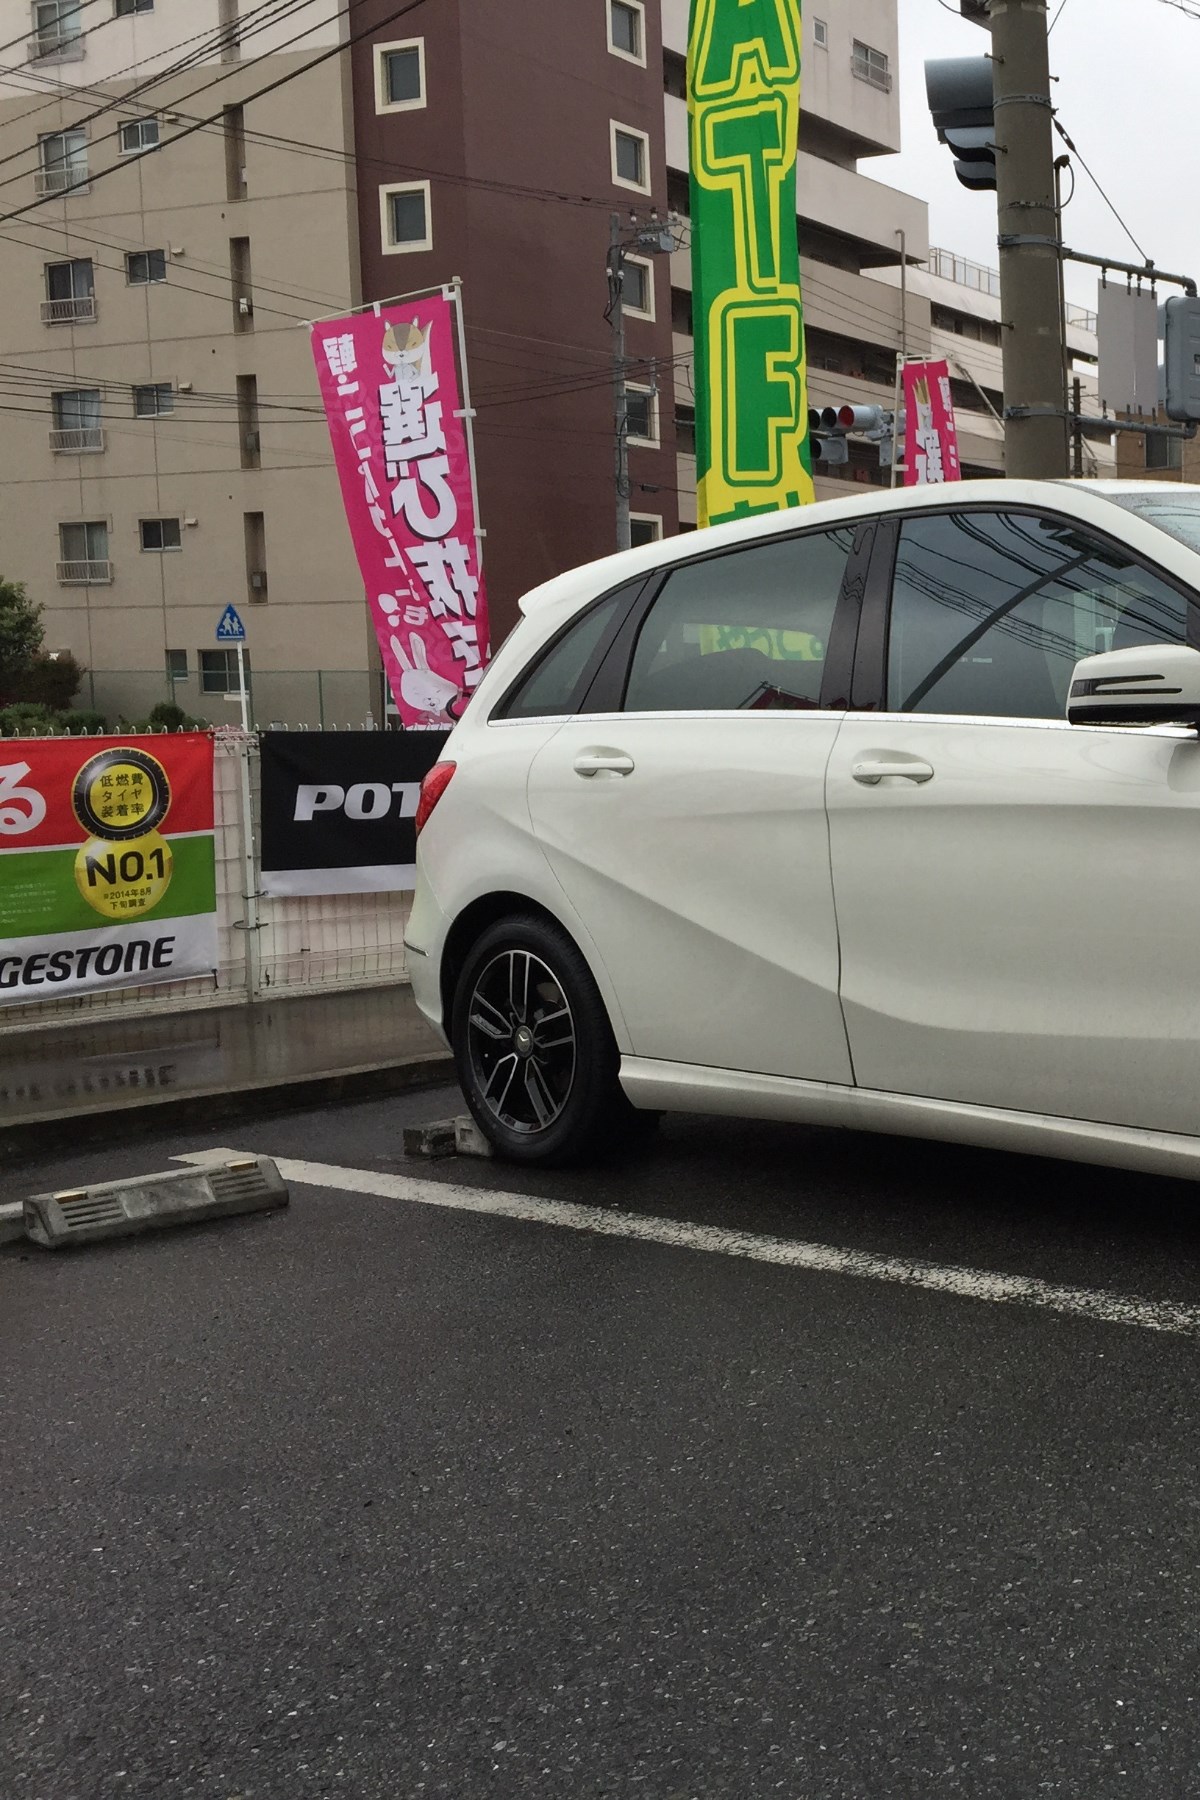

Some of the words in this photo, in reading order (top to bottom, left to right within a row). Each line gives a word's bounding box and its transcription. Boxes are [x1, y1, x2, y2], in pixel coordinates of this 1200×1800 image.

[100, 773, 143, 788] 低燃費
[102, 788, 143, 802] タイヤ
[294, 782, 421, 821] POT
[102, 802, 145, 818] 装着率
[85, 848, 165, 887] NO.1
[110, 898, 147, 911] 下旬調査
